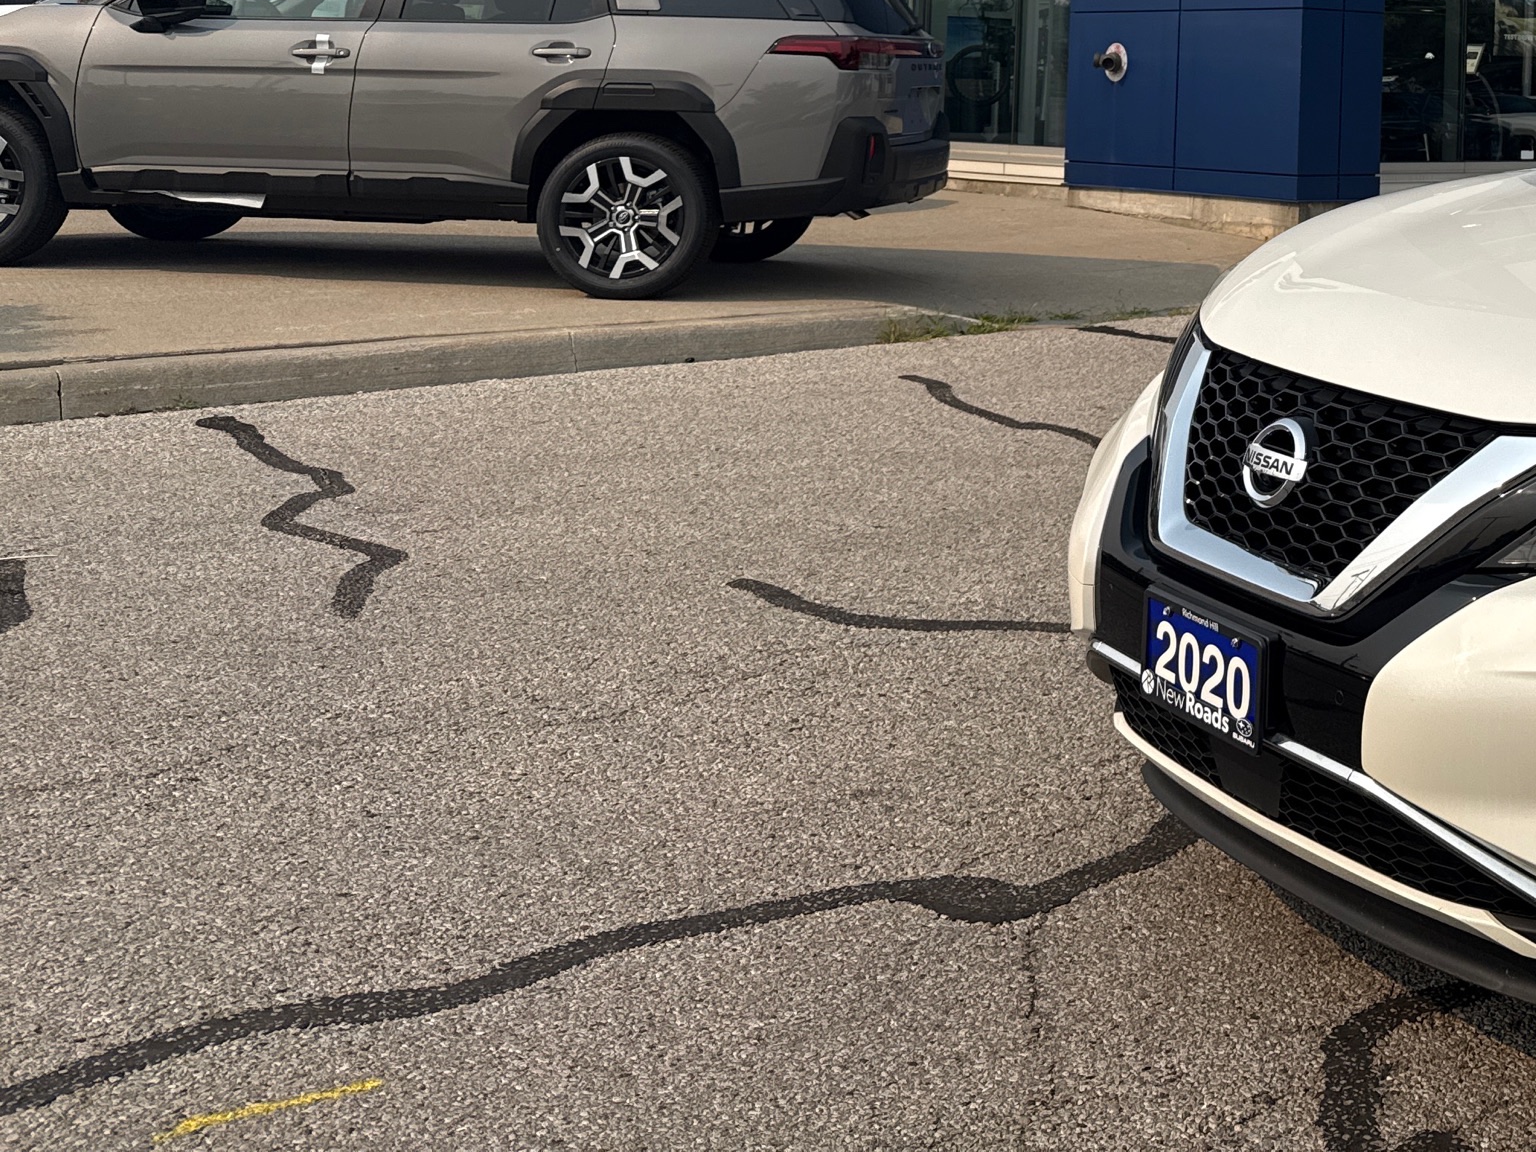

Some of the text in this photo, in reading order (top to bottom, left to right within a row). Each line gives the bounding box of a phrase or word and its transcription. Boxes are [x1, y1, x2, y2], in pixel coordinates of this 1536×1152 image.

[1245, 447, 1294, 476] NISSAN
[1182, 607, 1219, 632] Richmond Hill
[1155, 620, 1251, 720] 2020
[1232, 731, 1255, 749] SUBARU
